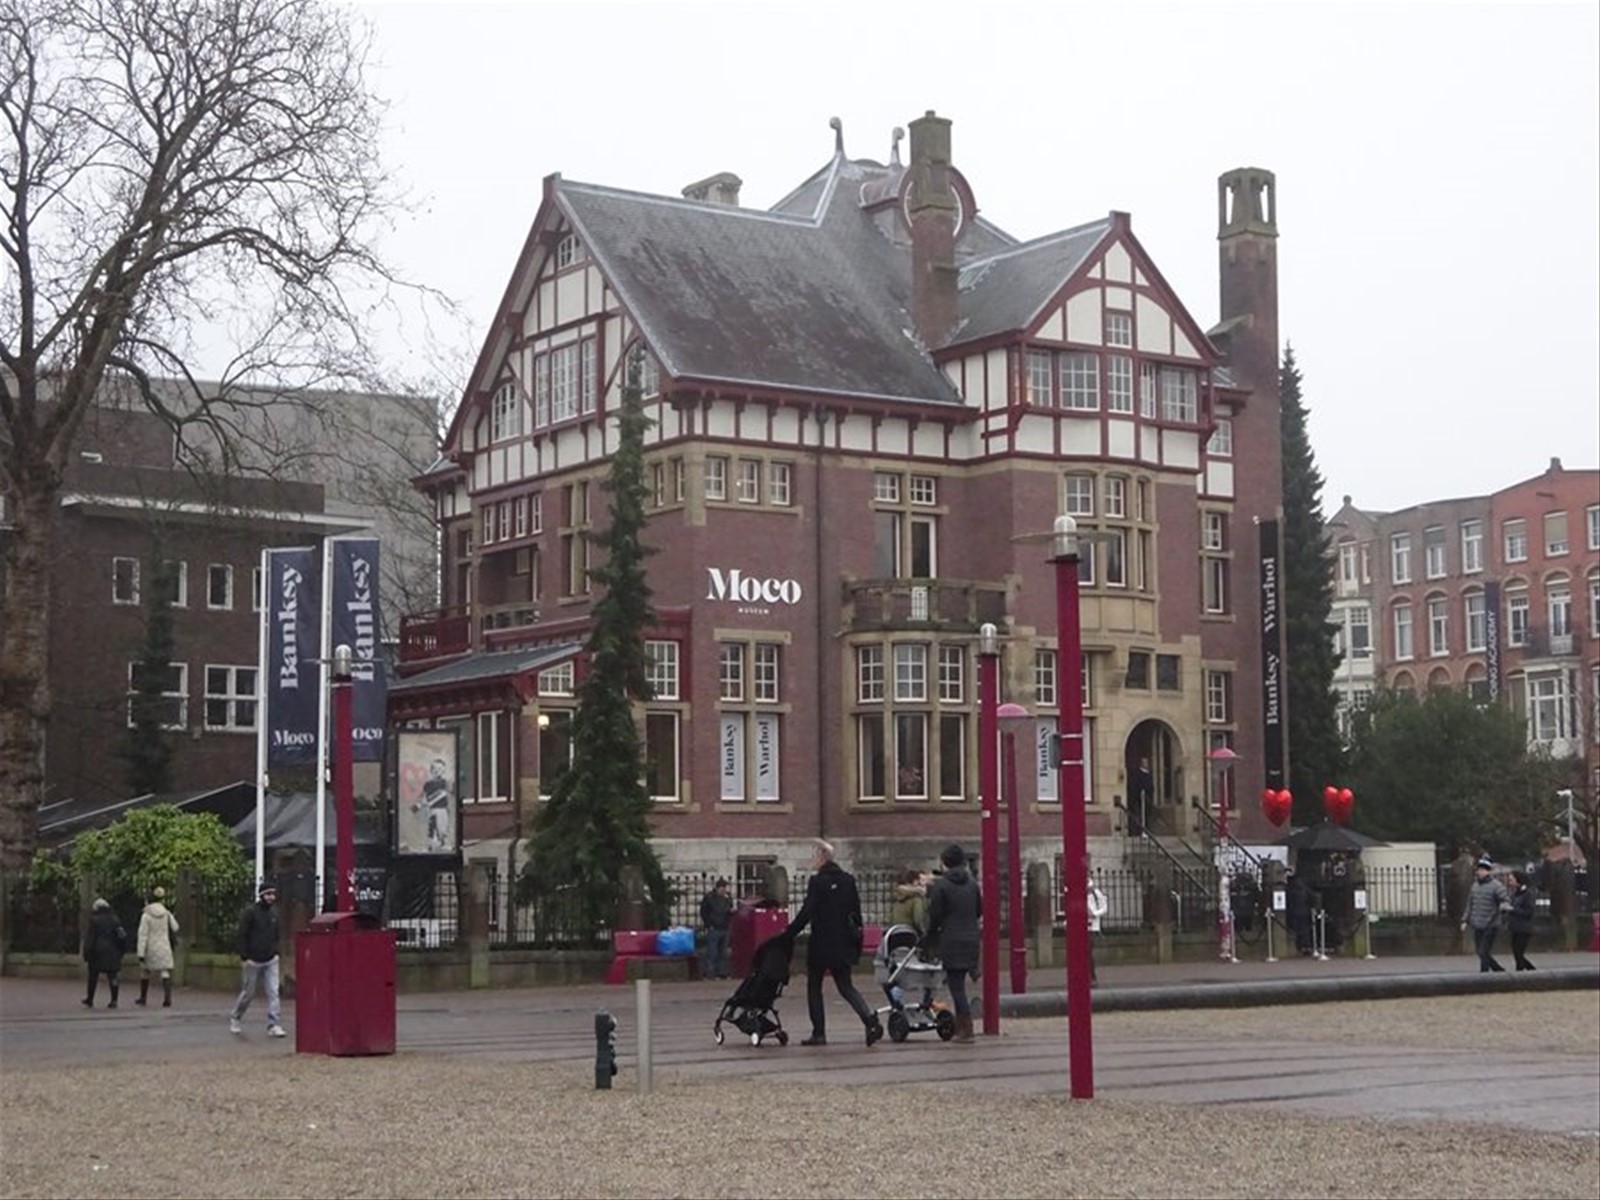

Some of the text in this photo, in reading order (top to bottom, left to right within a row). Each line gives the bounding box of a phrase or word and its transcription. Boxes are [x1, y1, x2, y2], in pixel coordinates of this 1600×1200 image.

[706, 567, 802, 605] Moco
[278, 564, 303, 690] Banksy
[347, 553, 375, 682] Banksy
[1263, 558, 1280, 724] Banksy Warhol
[273, 729, 315, 746] Moco
[351, 727, 384, 741] oco
[724, 724, 738, 777] Banksy
[758, 721, 769, 777] Warhol
[1038, 726, 1049, 777] Banksy
